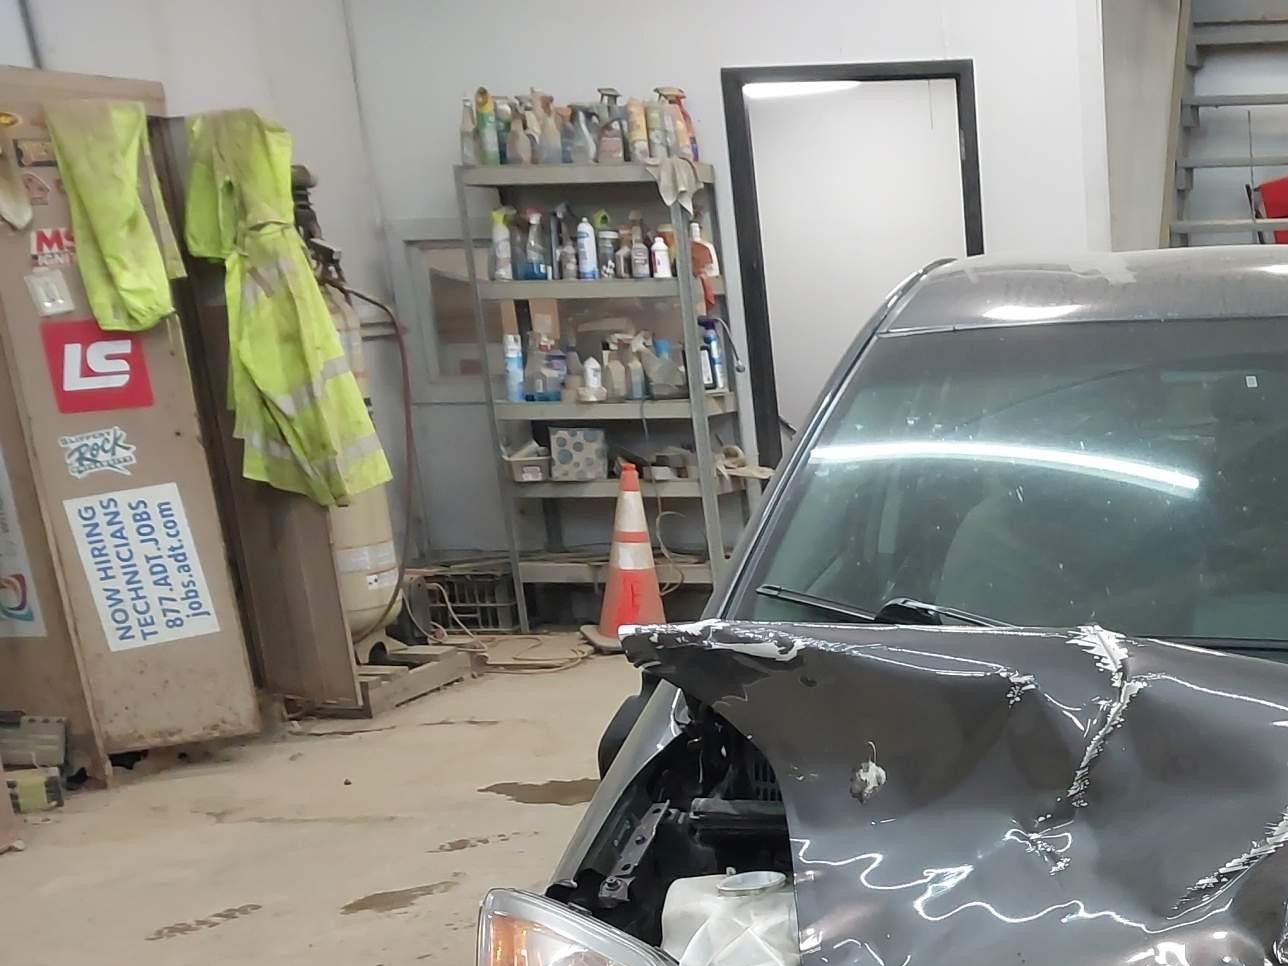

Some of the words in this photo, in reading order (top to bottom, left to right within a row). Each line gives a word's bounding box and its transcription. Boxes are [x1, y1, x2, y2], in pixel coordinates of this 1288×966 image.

[78, 505, 116, 582] HIRING
[99, 497, 158, 641] TECHNICIANS
[128, 499, 184, 629] 877.ADT.JOBS
[157, 501, 211, 618] jobs.adt.com
[102, 588, 136, 641] NOW
